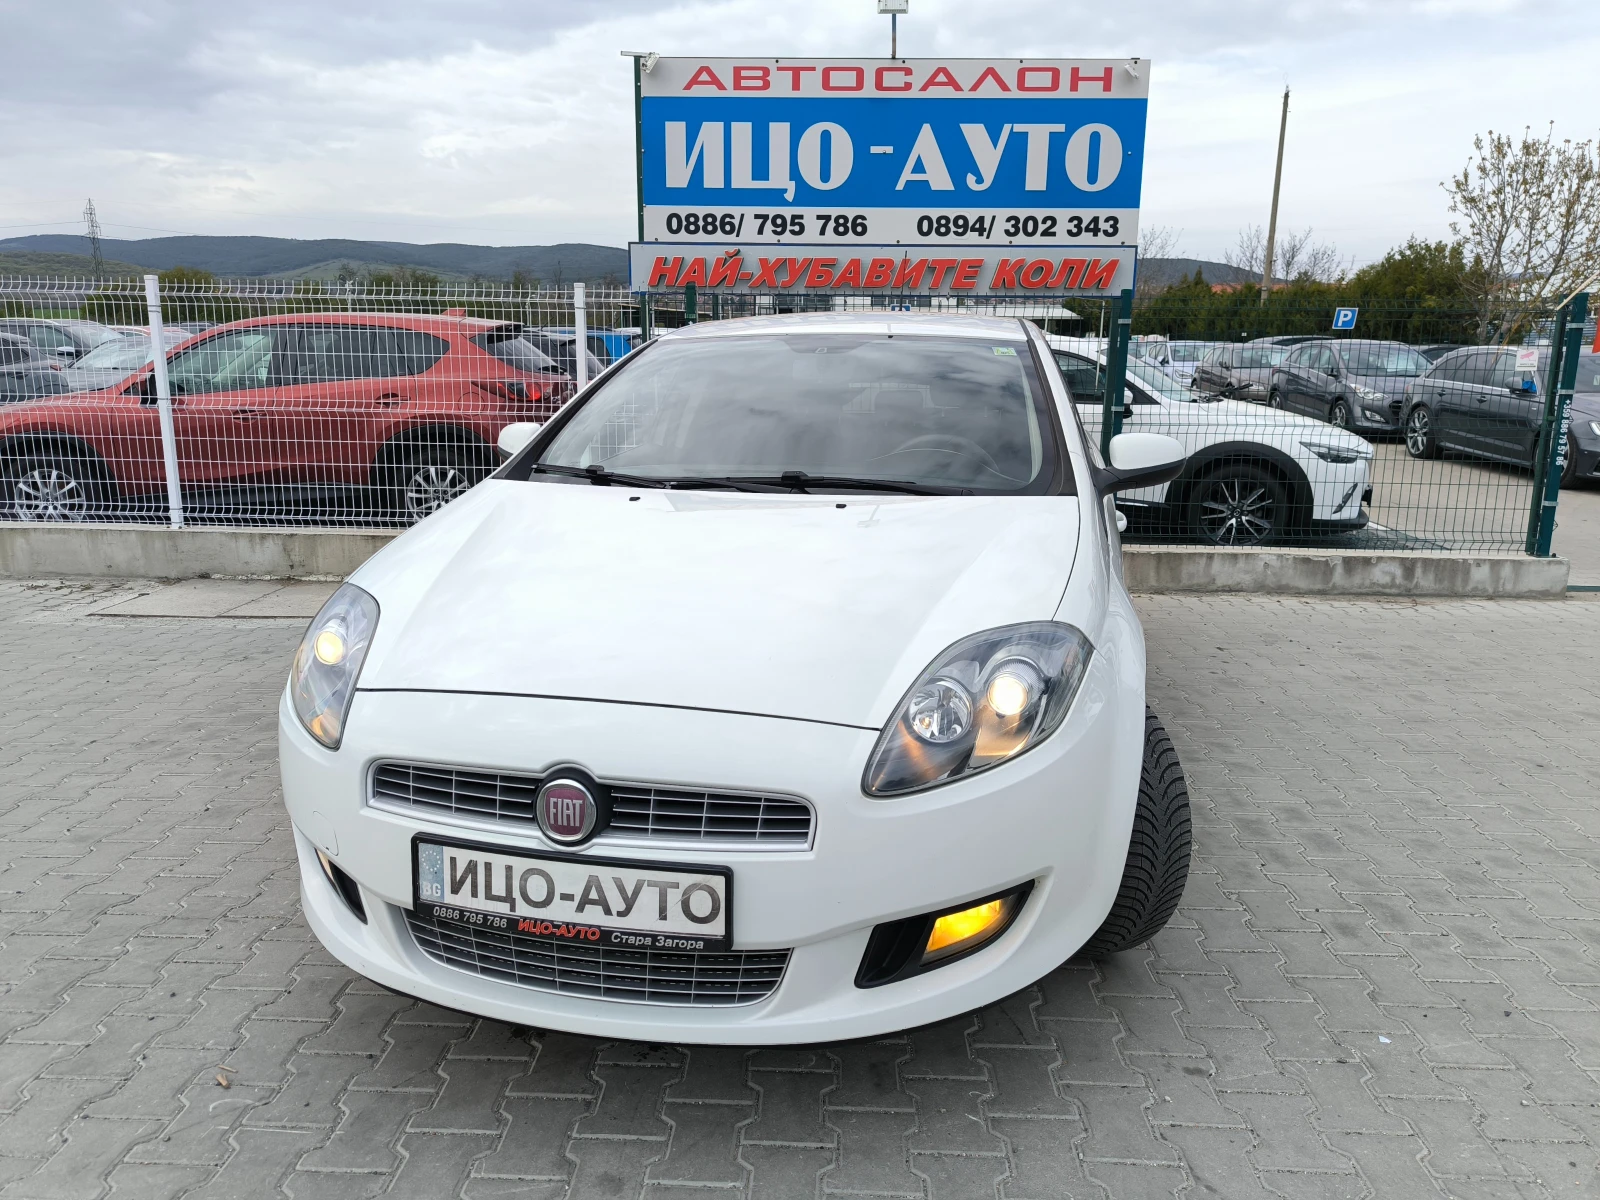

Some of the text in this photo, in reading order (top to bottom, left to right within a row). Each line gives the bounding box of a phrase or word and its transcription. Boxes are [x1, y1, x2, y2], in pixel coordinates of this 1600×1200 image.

[683, 66, 1113, 92] АВТОСАЛОН
[666, 213, 1120, 239] 0886/ 795 786 0894/ 302 343
[648, 248, 1121, 290] НАЙ-ХУБАВИТЕ КОЛИ
[549, 798, 583, 827] FIAT
[421, 881, 442, 897] BG
[449, 856, 721, 924] ИЦО-АУТО
[433, 906, 704, 950] 0886 795 786 ИЦО-АУТО Стара Загора
